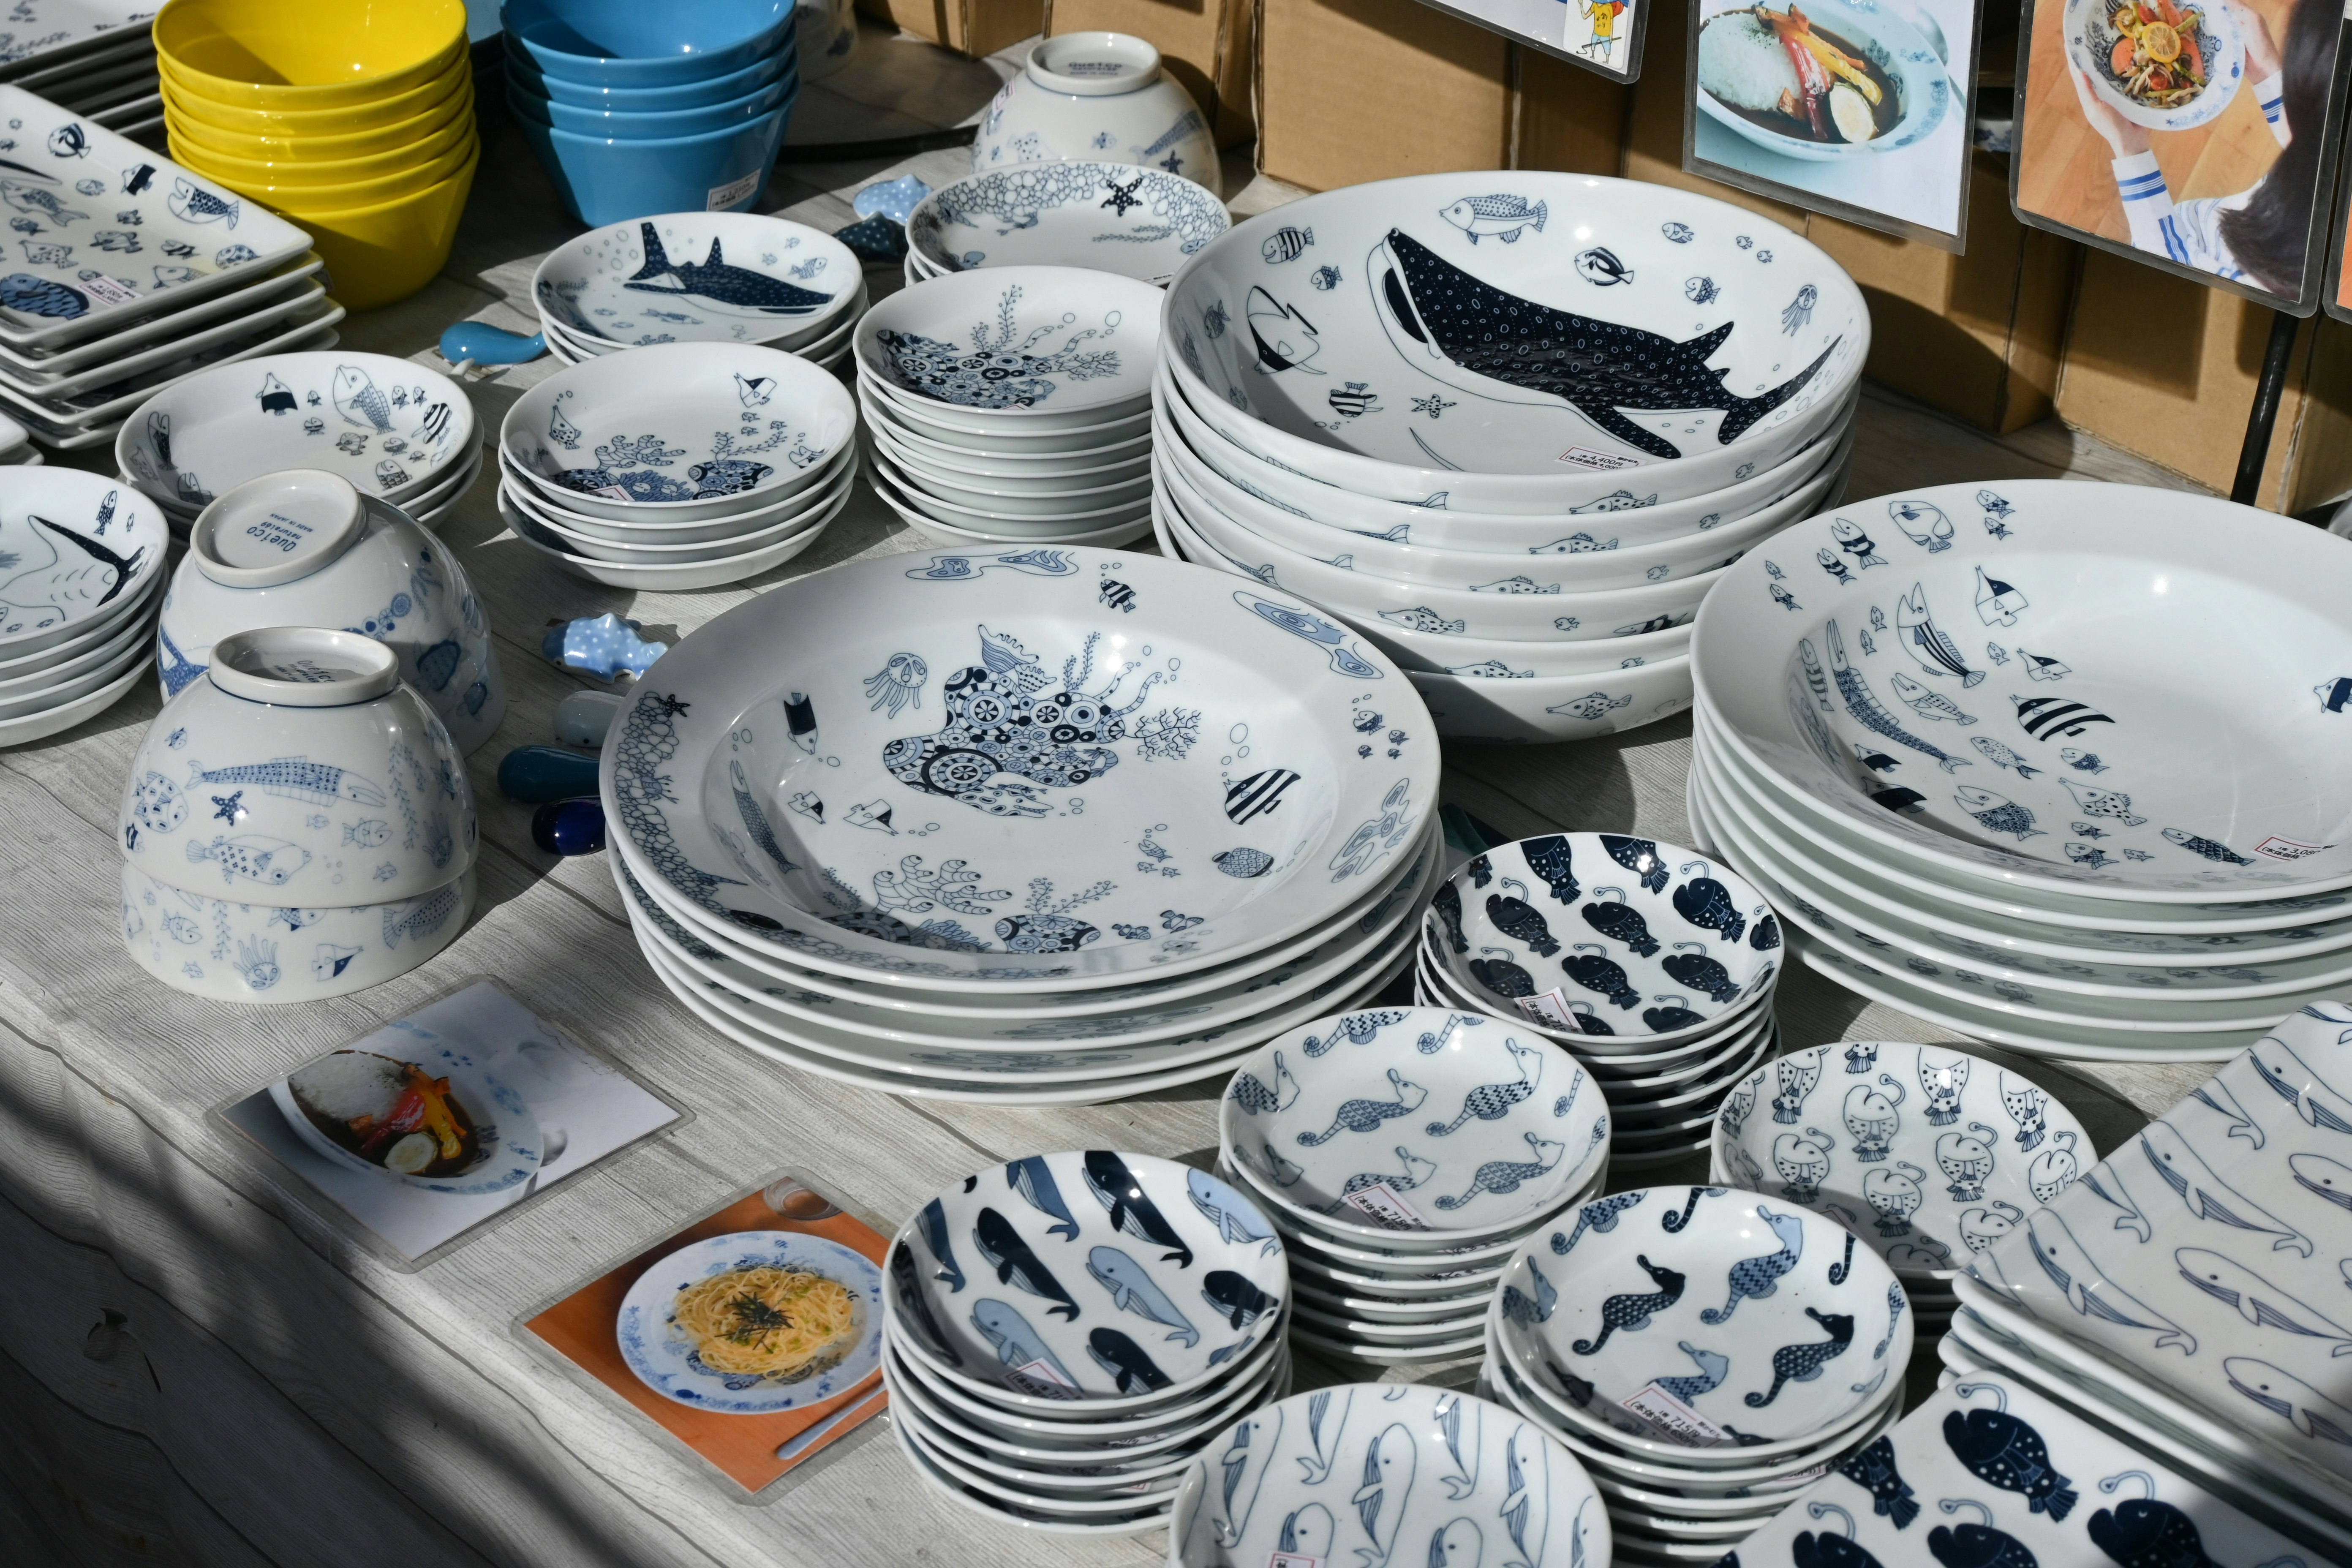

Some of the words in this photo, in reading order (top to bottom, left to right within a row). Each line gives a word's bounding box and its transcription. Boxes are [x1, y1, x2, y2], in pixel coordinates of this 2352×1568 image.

[1565, 455, 1598, 466] (本体価格
[1589, 455, 1623, 466] 4,400円
[270, 513, 290, 522] JAPAN
[260, 521, 302, 539] natural69
[296, 523, 314, 533] MADE
[246, 526, 297, 552] Queico
[2261, 846, 2300, 860] (本体価格
[1525, 1001, 1550, 1026] (本体価格
[1354, 1195, 1388, 1223] (本体価格
[1387, 1211, 1413, 1230] 715円
[1630, 1400, 1672, 1431] (本体価格
[1670, 1416, 1701, 1438] 715円
